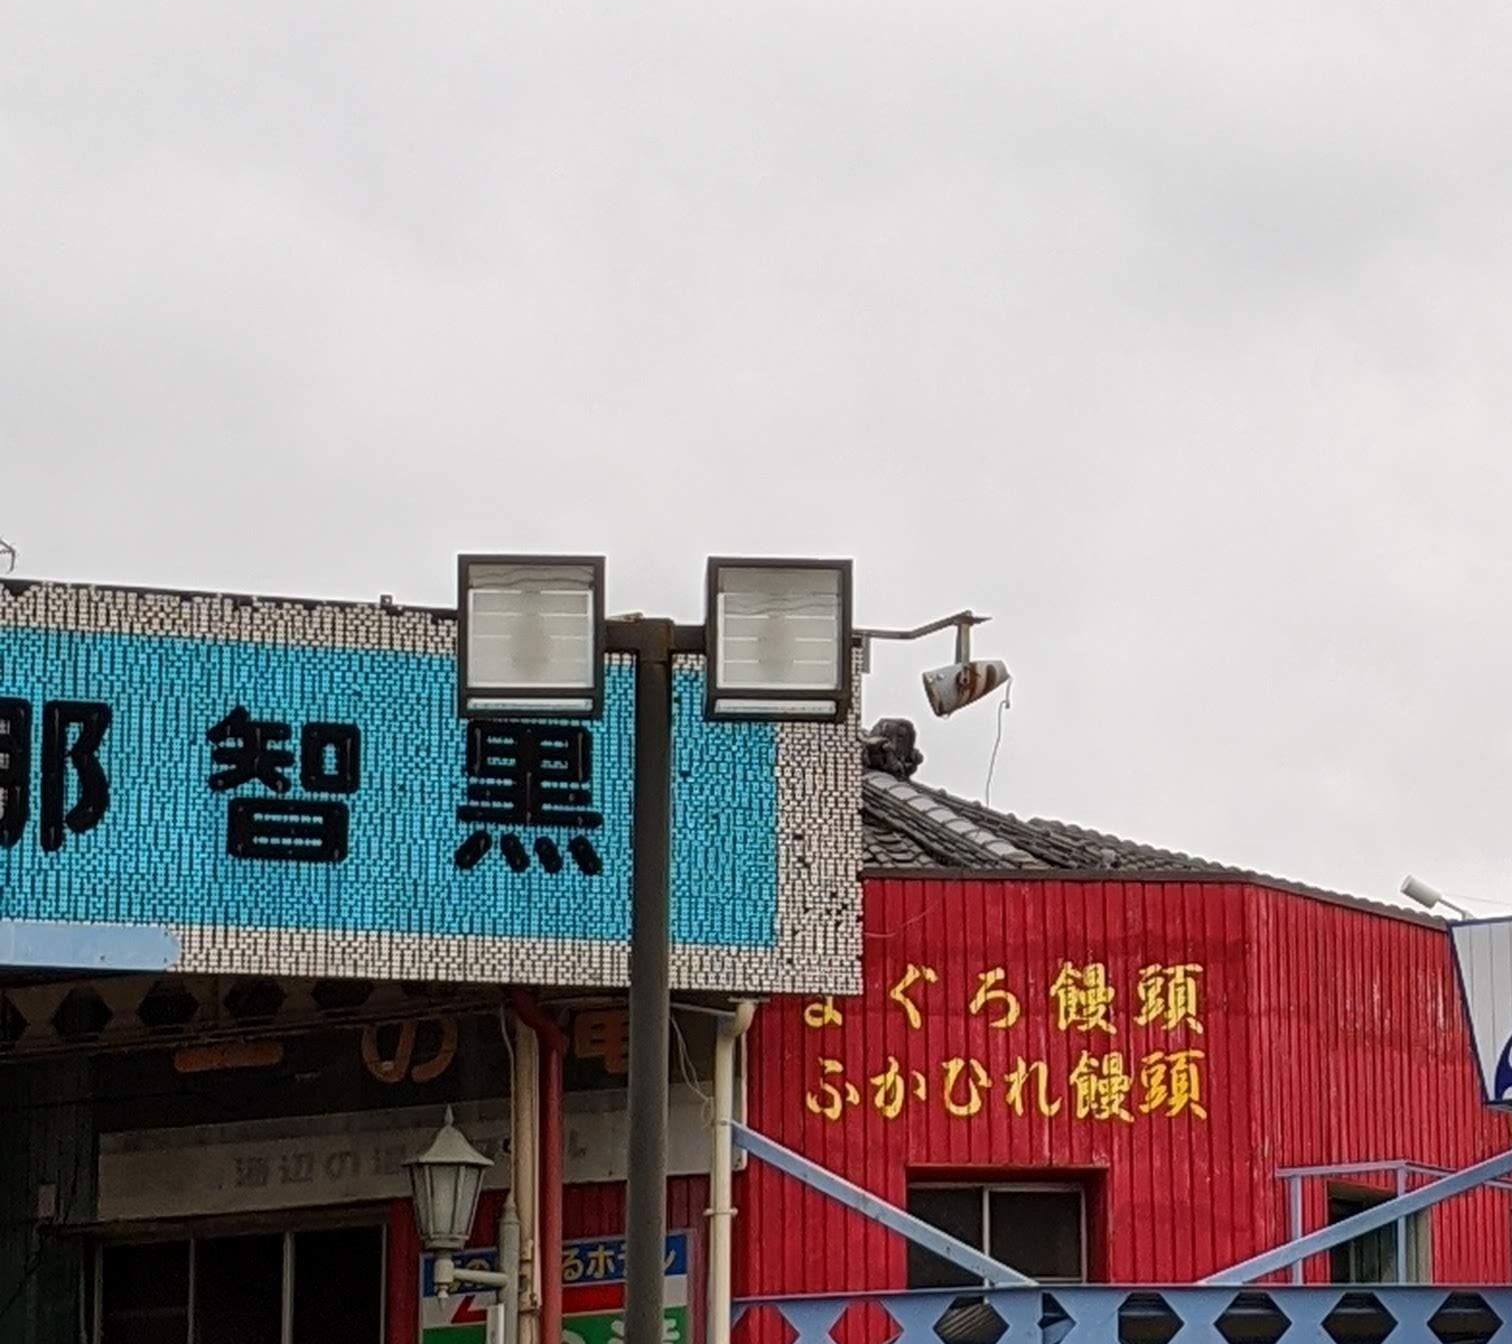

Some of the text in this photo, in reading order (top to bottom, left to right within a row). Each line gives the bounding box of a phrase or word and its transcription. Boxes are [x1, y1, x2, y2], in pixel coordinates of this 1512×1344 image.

[804, 1049, 1208, 1122] ふかひれ饅頭
